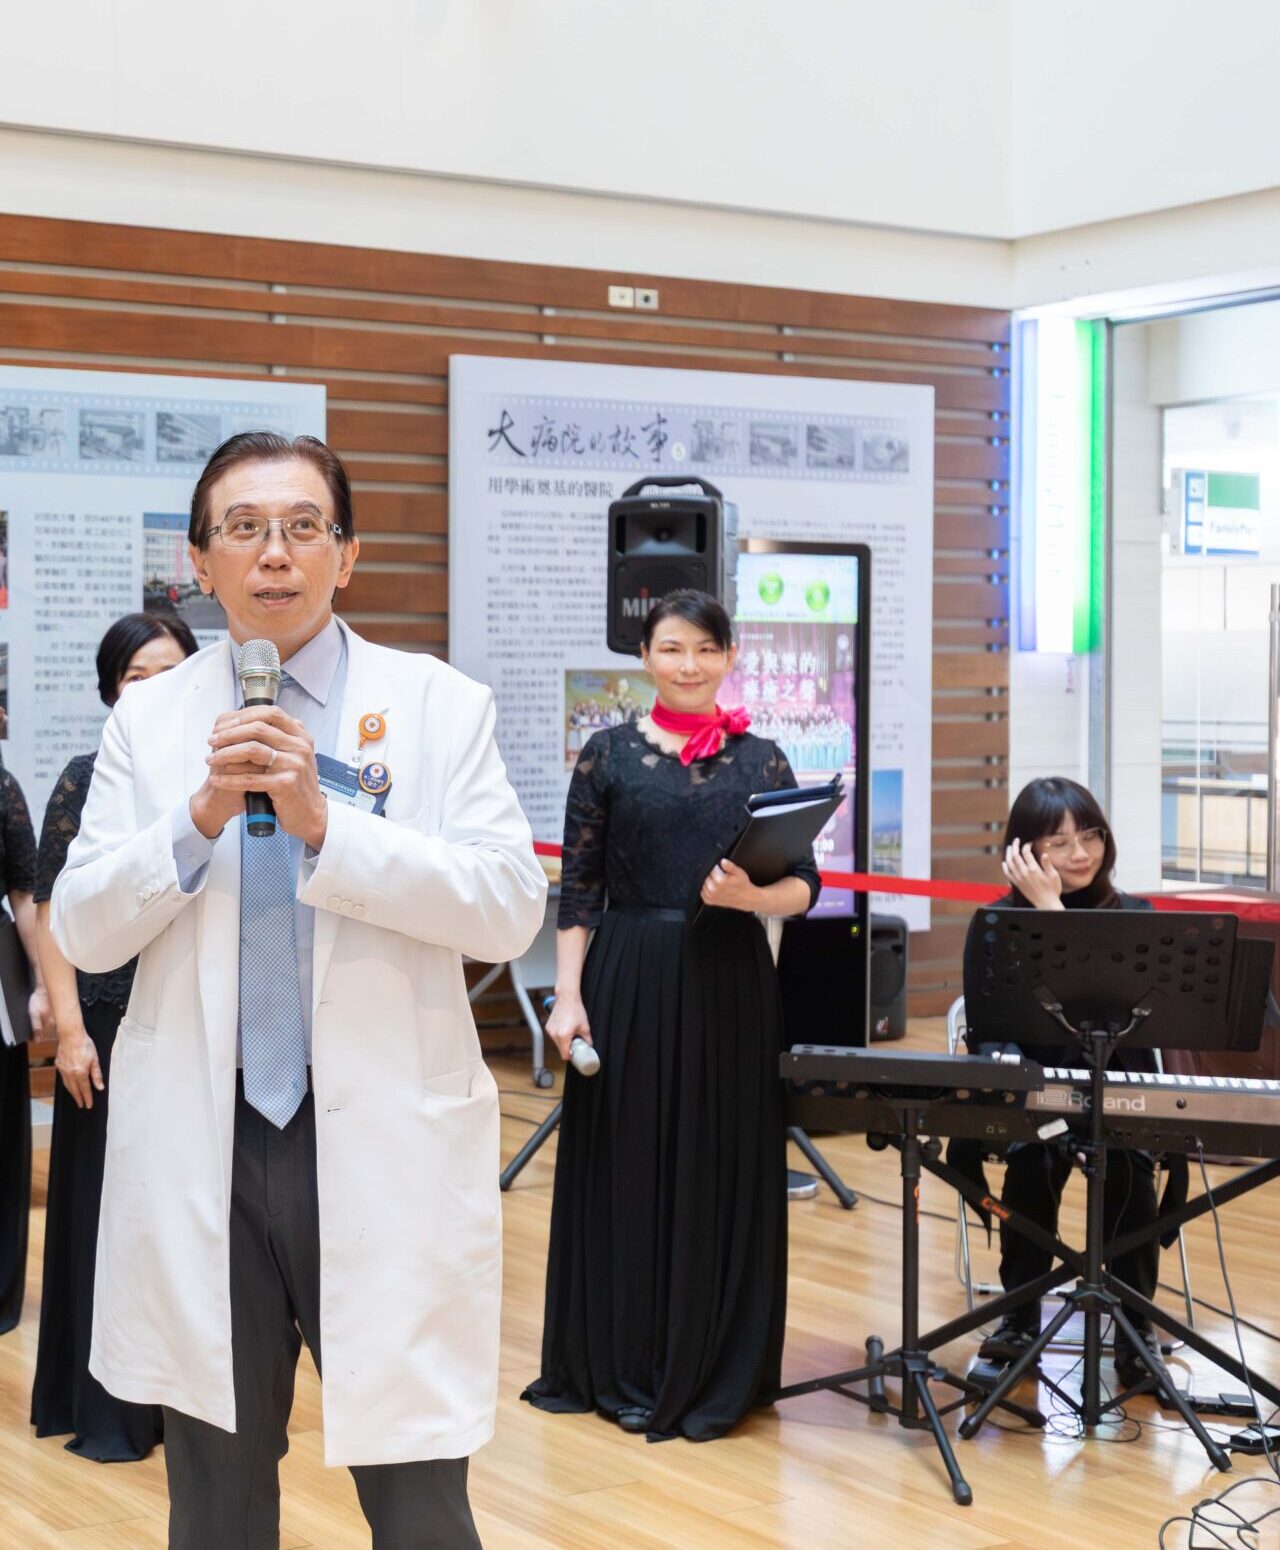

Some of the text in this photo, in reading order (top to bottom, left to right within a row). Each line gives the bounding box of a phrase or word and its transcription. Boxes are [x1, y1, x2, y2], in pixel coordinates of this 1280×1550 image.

[488, 409, 670, 463] 大病院的故事
[1067, 1089, 1147, 1113] Roand
